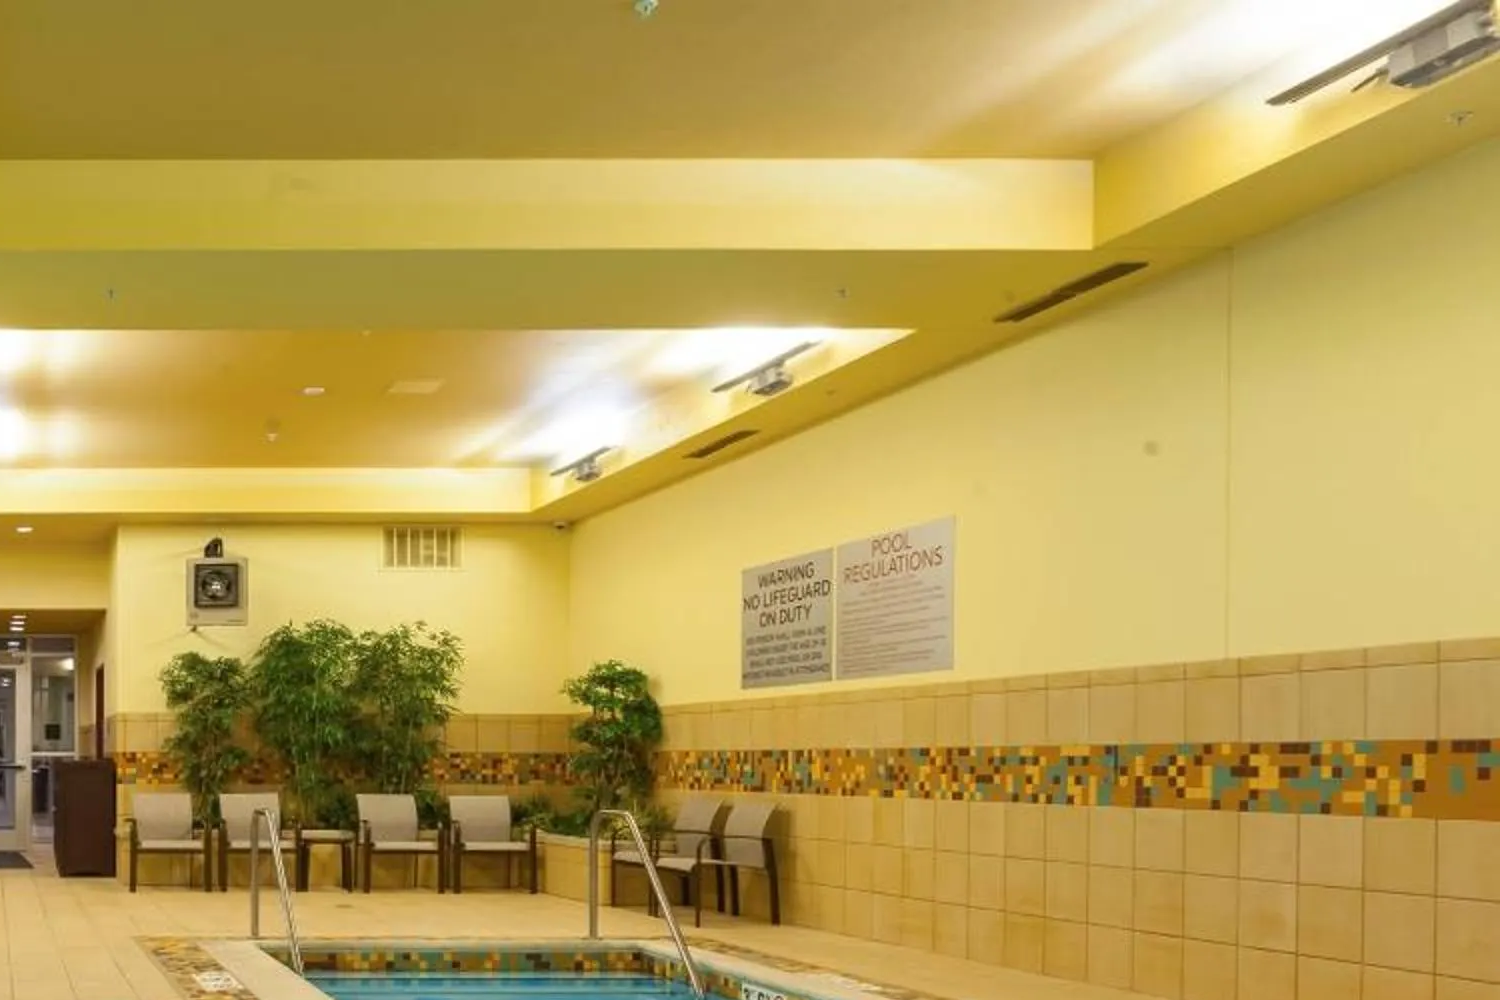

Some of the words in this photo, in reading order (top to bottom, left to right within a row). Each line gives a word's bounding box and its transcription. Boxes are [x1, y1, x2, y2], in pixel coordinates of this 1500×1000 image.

[870, 531, 913, 558] POOL
[757, 561, 815, 589] WARNING
[843, 545, 944, 584] REGULATIONS
[743, 594, 760, 612] NO
[762, 579, 831, 608] LIFEGUARD
[759, 611, 777, 628] ON
[779, 603, 813, 625] DUTY
